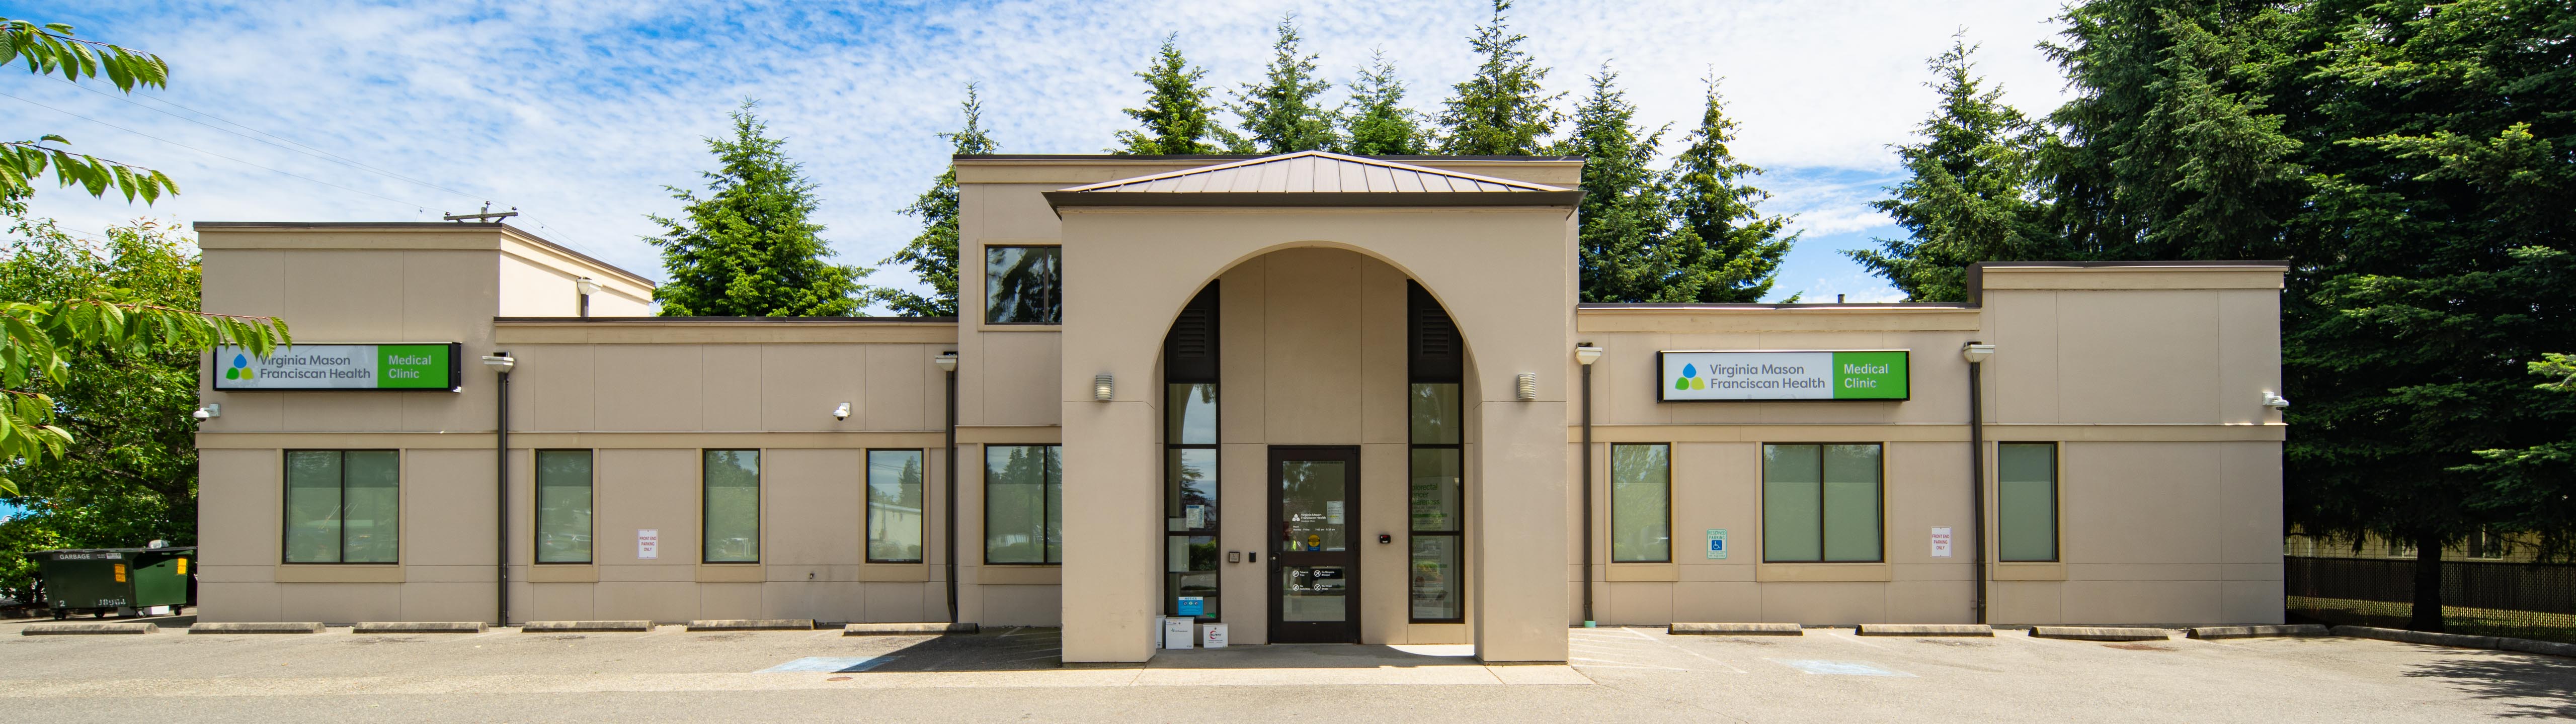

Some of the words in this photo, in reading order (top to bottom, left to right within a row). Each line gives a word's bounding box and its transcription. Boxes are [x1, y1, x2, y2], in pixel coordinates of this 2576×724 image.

[260, 355, 306, 368] Virginia
[310, 355, 351, 365] Mason
[388, 355, 431, 365] Medical
[260, 369, 326, 378] Franciscan
[330, 369, 370, 378] Health
[388, 368, 420, 378] Clinic
[1710, 364, 1758, 378] Virginia
[1761, 364, 1804, 374] Mason
[1844, 364, 1889, 374] Medical
[1711, 378, 1779, 388] Franciscan
[1783, 378, 1825, 388] Health
[1844, 378, 1876, 388] Clinic
